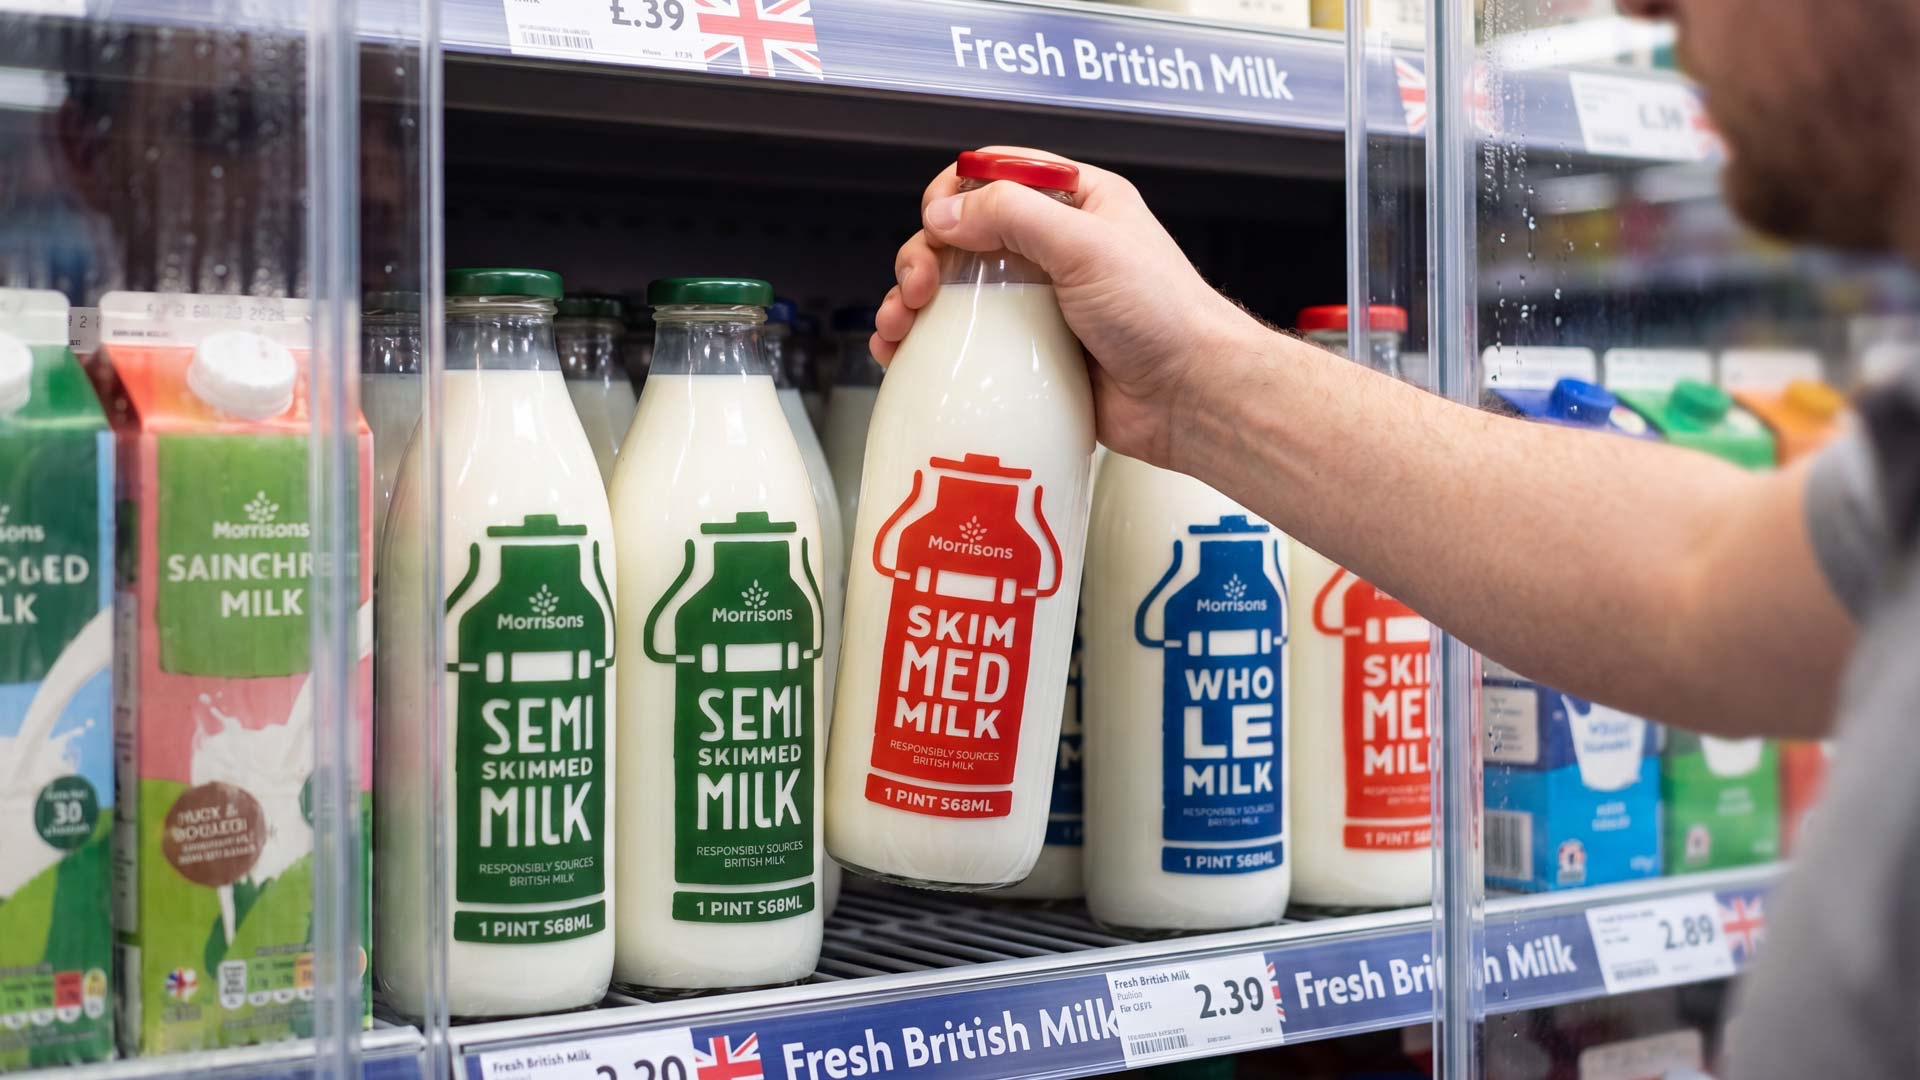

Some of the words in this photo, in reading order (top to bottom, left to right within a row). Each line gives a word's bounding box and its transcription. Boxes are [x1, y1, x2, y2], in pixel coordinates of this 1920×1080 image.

[951, 26, 1066, 78] Fresh
[1074, 38, 1204, 91] British
[1210, 53, 1294, 101] Milk
[213, 520, 310, 540] Morrisons
[928, 535, 1014, 559] Morrisons
[222, 588, 304, 618] MILK
[1197, 599, 1267, 612] Morrisons
[497, 613, 585, 630] Morrisons
[712, 607, 793, 623] Morrisons
[906, 604, 1016, 648] SKIM
[898, 640, 1010, 703] MED
[1363, 652, 1432, 686] SKI
[1185, 666, 1274, 700] WHO
[481, 695, 593, 755] SEMI
[698, 685, 802, 742] SEMI
[893, 696, 1001, 739] MILK
[1363, 688, 1432, 740] ME
[1184, 703, 1274, 759] LE
[698, 744, 802, 766] SKIMMED
[890, 740, 955, 760] RESPONSIBLY
[956, 750, 999, 761] SOURCES
[481, 757, 593, 780] SKIMMED
[913, 755, 950, 769] BRITISH
[952, 761, 974, 770] MILK
[1184, 761, 1273, 796] MILK
[697, 768, 801, 830] MILK
[884, 787, 892, 800] 1
[896, 789, 937, 808] PINT
[54, 800, 83, 825] 30
[480, 781, 592, 847] MILK
[696, 844, 764, 856] RESPONSIBLY
[766, 840, 803, 853] SOURCES
[1376, 831, 1411, 845] PINT
[479, 862, 552, 874] RESPONSIBLY
[554, 856, 594, 871] SOURCES
[724, 858, 763, 868] BRITISH
[764, 856, 785, 866] MILK
[1184, 856, 1191, 868] 1
[1196, 855, 1232, 869] PINT
[509, 875, 550, 887] BRITISH
[552, 873, 575, 884] MILK
[696, 901, 704, 915] 1
[711, 901, 753, 916] PINT
[479, 922, 487, 936] 1
[494, 920, 540, 937] PINT
[1659, 914, 1714, 950] 2.89
[1114, 977, 1138, 990] Fresh
[1139, 972, 1169, 987] British
[1171, 970, 1190, 981] Milk
[1295, 960, 1386, 1008] Fresh
[1507, 934, 1578, 981] Milk
[782, 1028, 895, 1080] Fresh
[902, 1011, 1031, 1068] British
[1039, 998, 1121, 1049] Milk
[493, 1060, 524, 1073] Fresh
[527, 1054, 566, 1070] British
[568, 1051, 592, 1064] Milk
